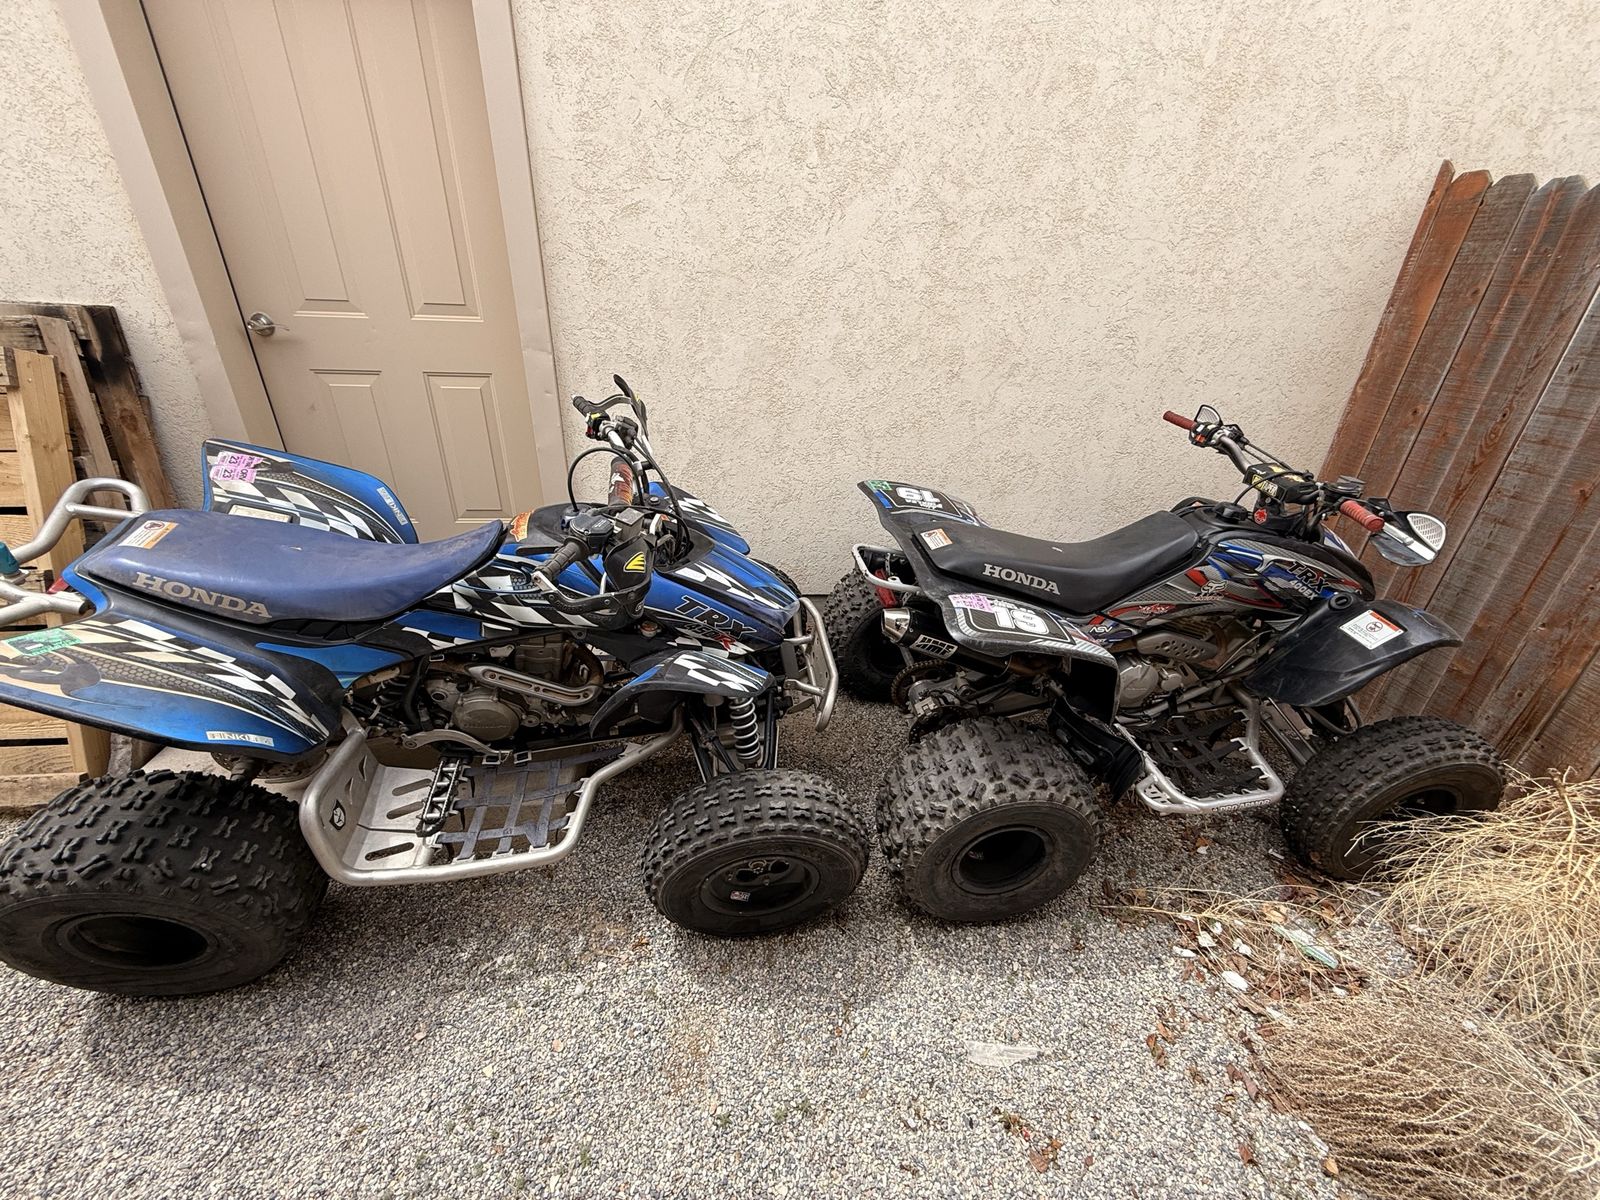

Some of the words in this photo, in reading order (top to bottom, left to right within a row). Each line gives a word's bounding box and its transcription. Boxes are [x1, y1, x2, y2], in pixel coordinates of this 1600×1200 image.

[228, 455, 240, 465] 23
[222, 469, 234, 479] 23
[982, 563, 1061, 595] HONDA
[1286, 560, 1331, 594] TRX
[132, 571, 273, 619] HONDA
[1289, 580, 1318, 601] 400EX
[674, 594, 758, 640] TRX
[1089, 625, 1113, 634] ASV
